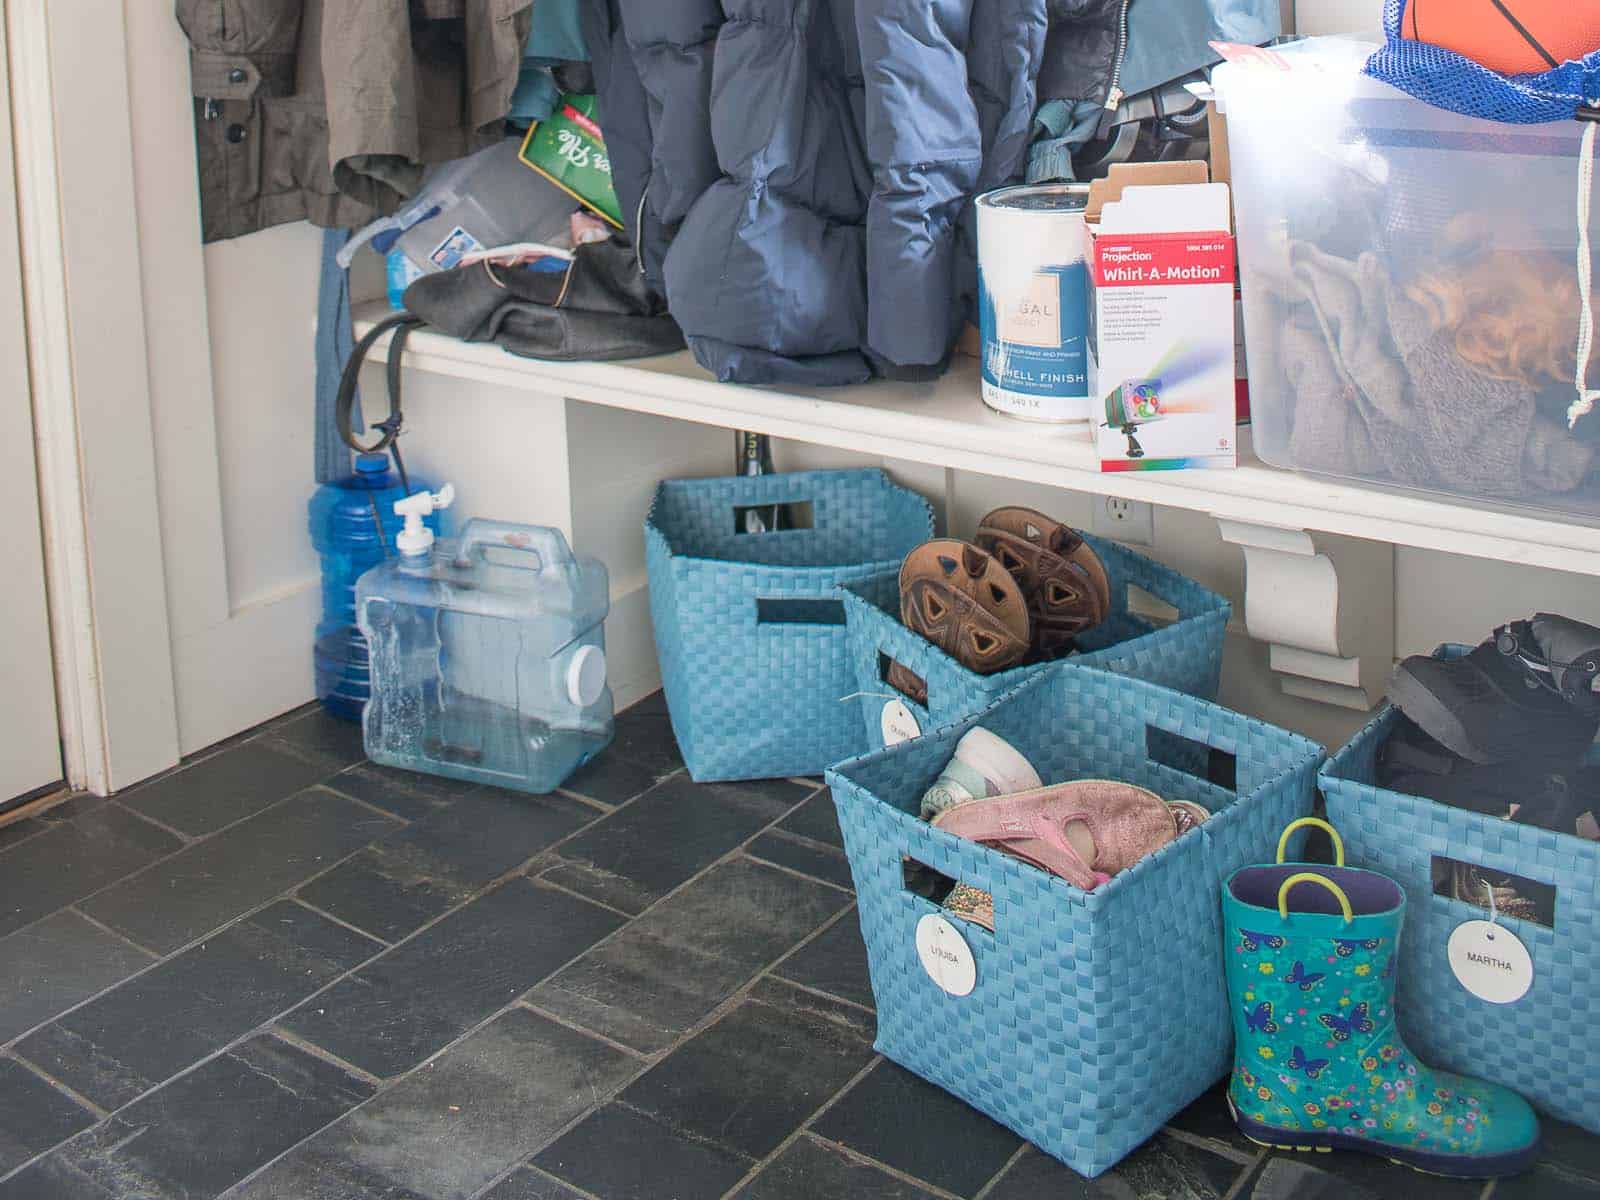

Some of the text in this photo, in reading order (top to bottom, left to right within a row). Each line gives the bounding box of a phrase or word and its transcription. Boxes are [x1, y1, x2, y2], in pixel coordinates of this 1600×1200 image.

[558, 129, 591, 168] Ale
[1102, 251, 1152, 264] Projection
[1040, 373, 1084, 383] FINISH
[930, 944, 959, 964] LOUISA
[1466, 951, 1512, 972] MARTHA
